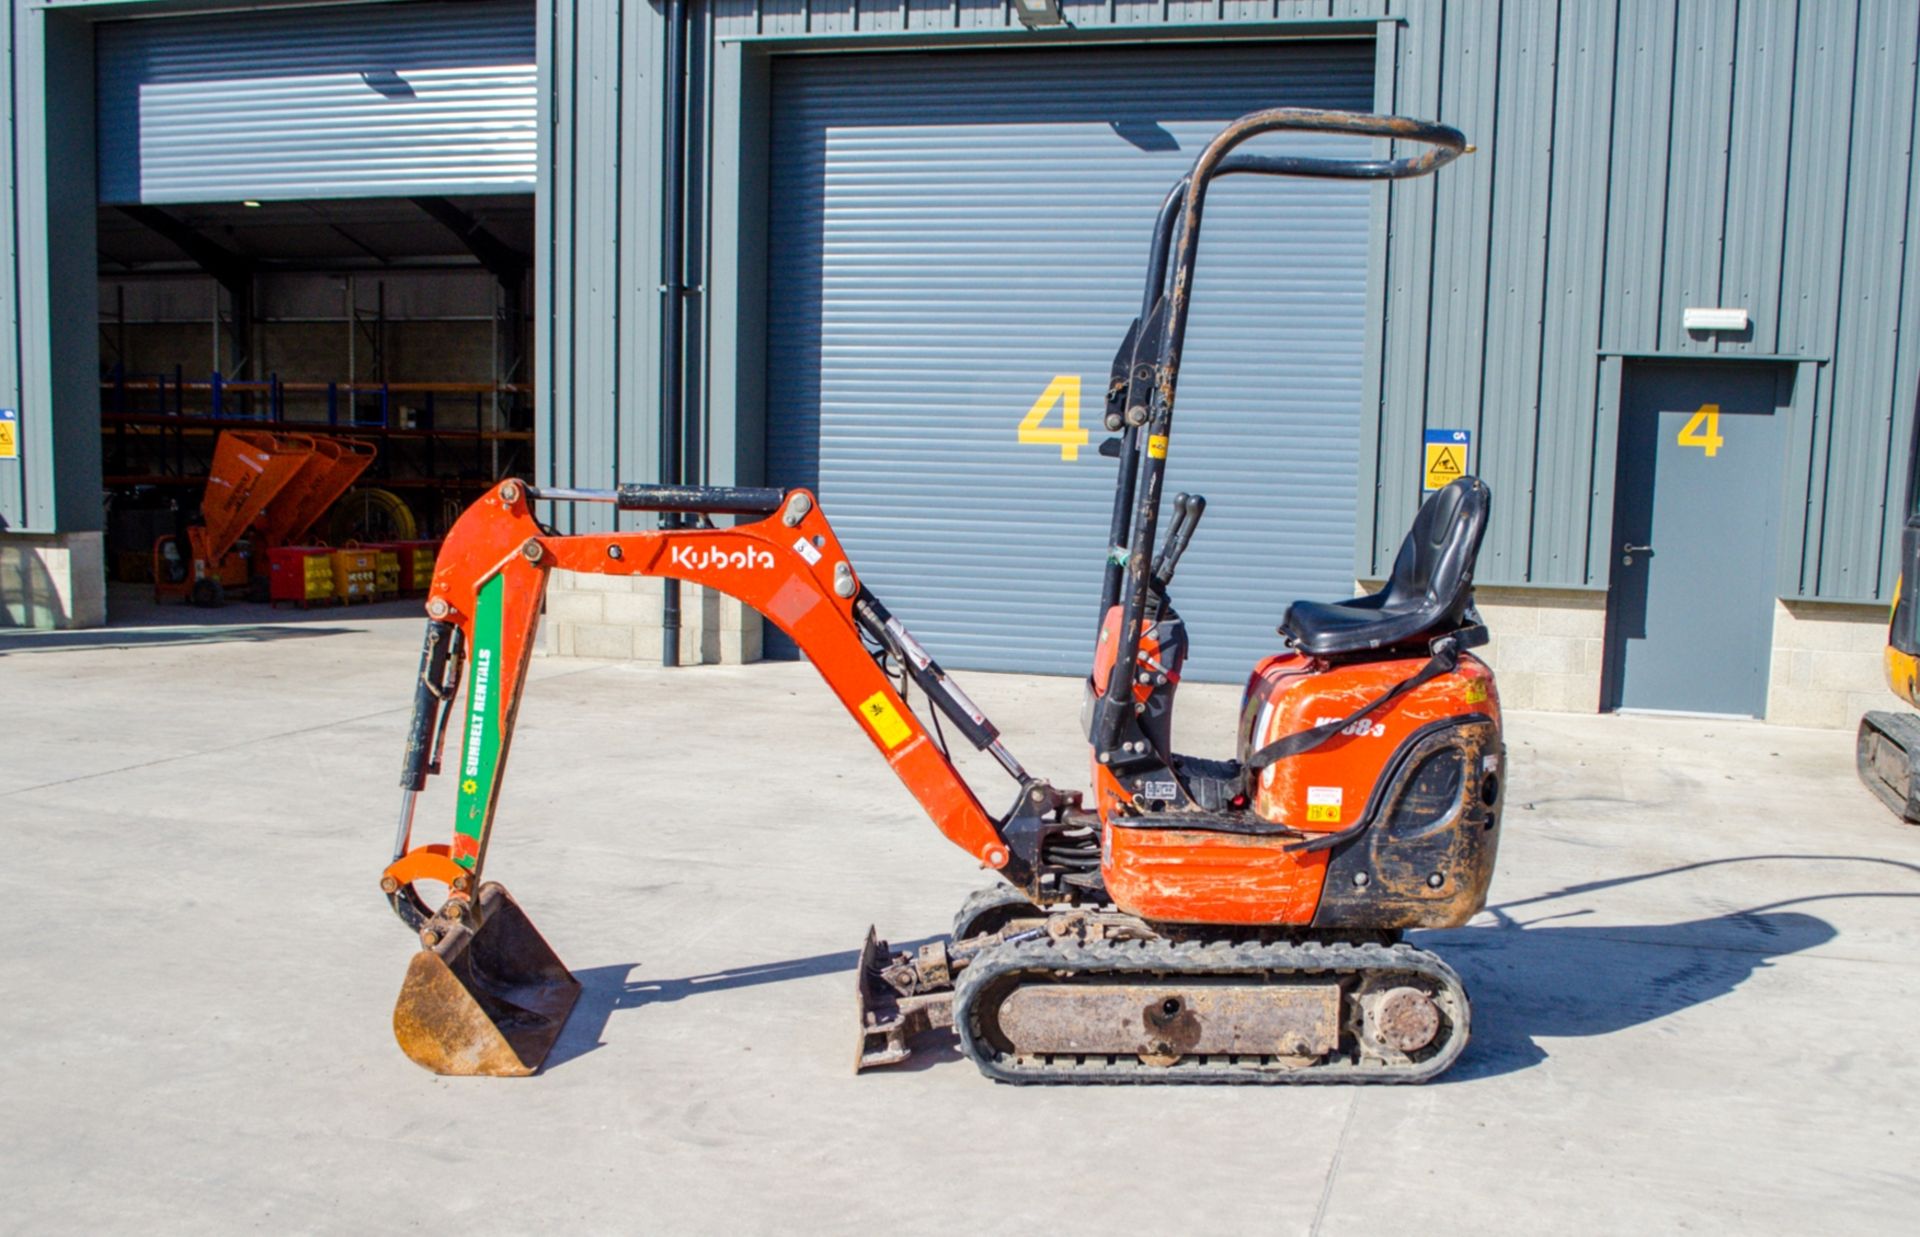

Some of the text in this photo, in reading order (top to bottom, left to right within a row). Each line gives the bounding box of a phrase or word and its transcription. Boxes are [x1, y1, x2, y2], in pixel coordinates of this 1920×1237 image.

[1018, 375, 1089, 461] 4
[1677, 403, 1724, 457] 4
[671, 545, 775, 569] Kubota
[466, 648, 491, 777] SUNBELT RENTALS
